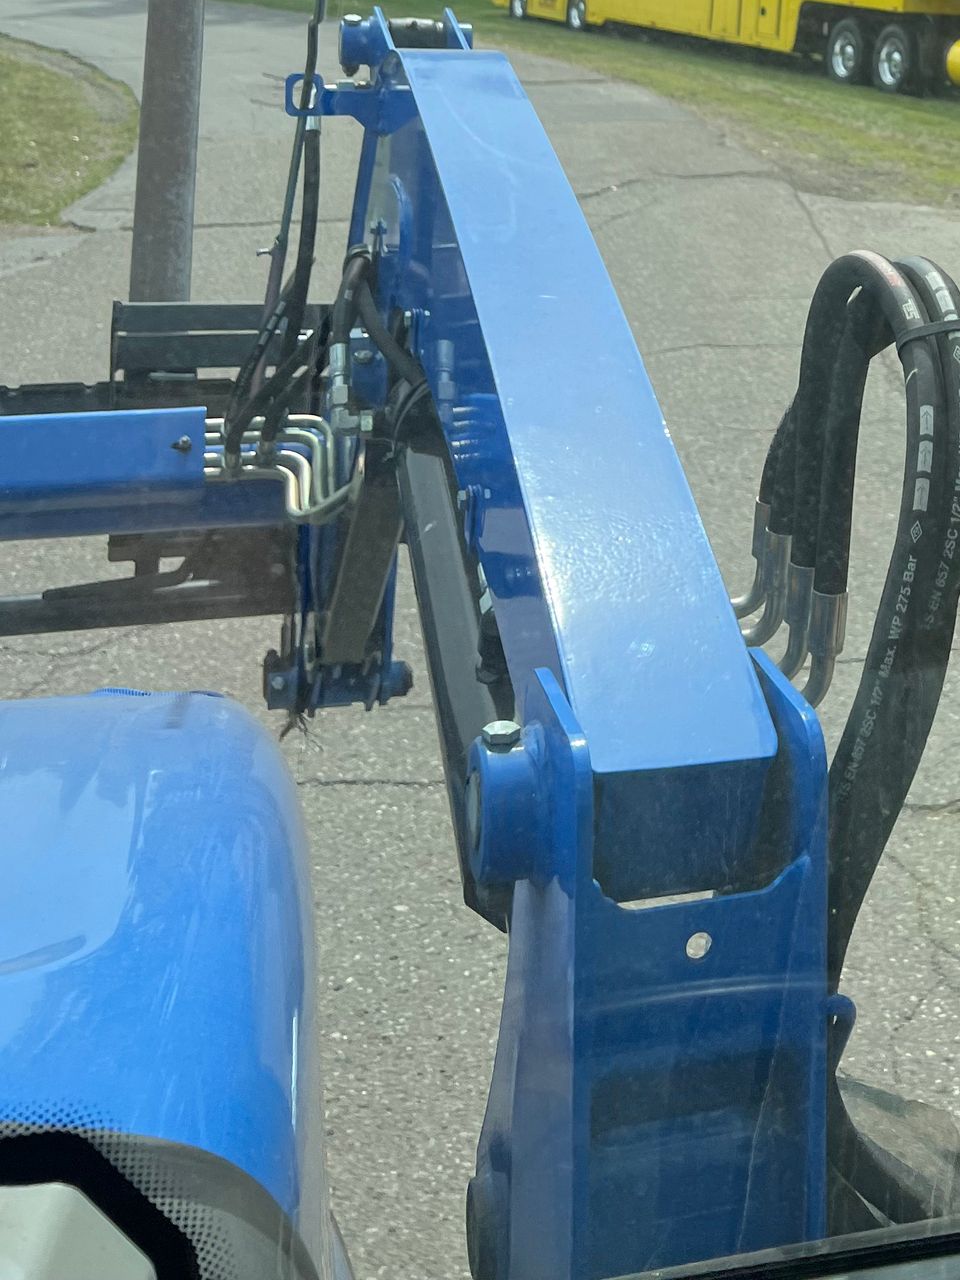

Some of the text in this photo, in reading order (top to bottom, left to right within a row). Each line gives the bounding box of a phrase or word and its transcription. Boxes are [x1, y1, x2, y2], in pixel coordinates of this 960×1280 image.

[943, 527, 958, 560] 2SC
[903, 553, 918, 583] Bar
[896, 585, 911, 614] 275
[888, 615, 903, 639] WP
